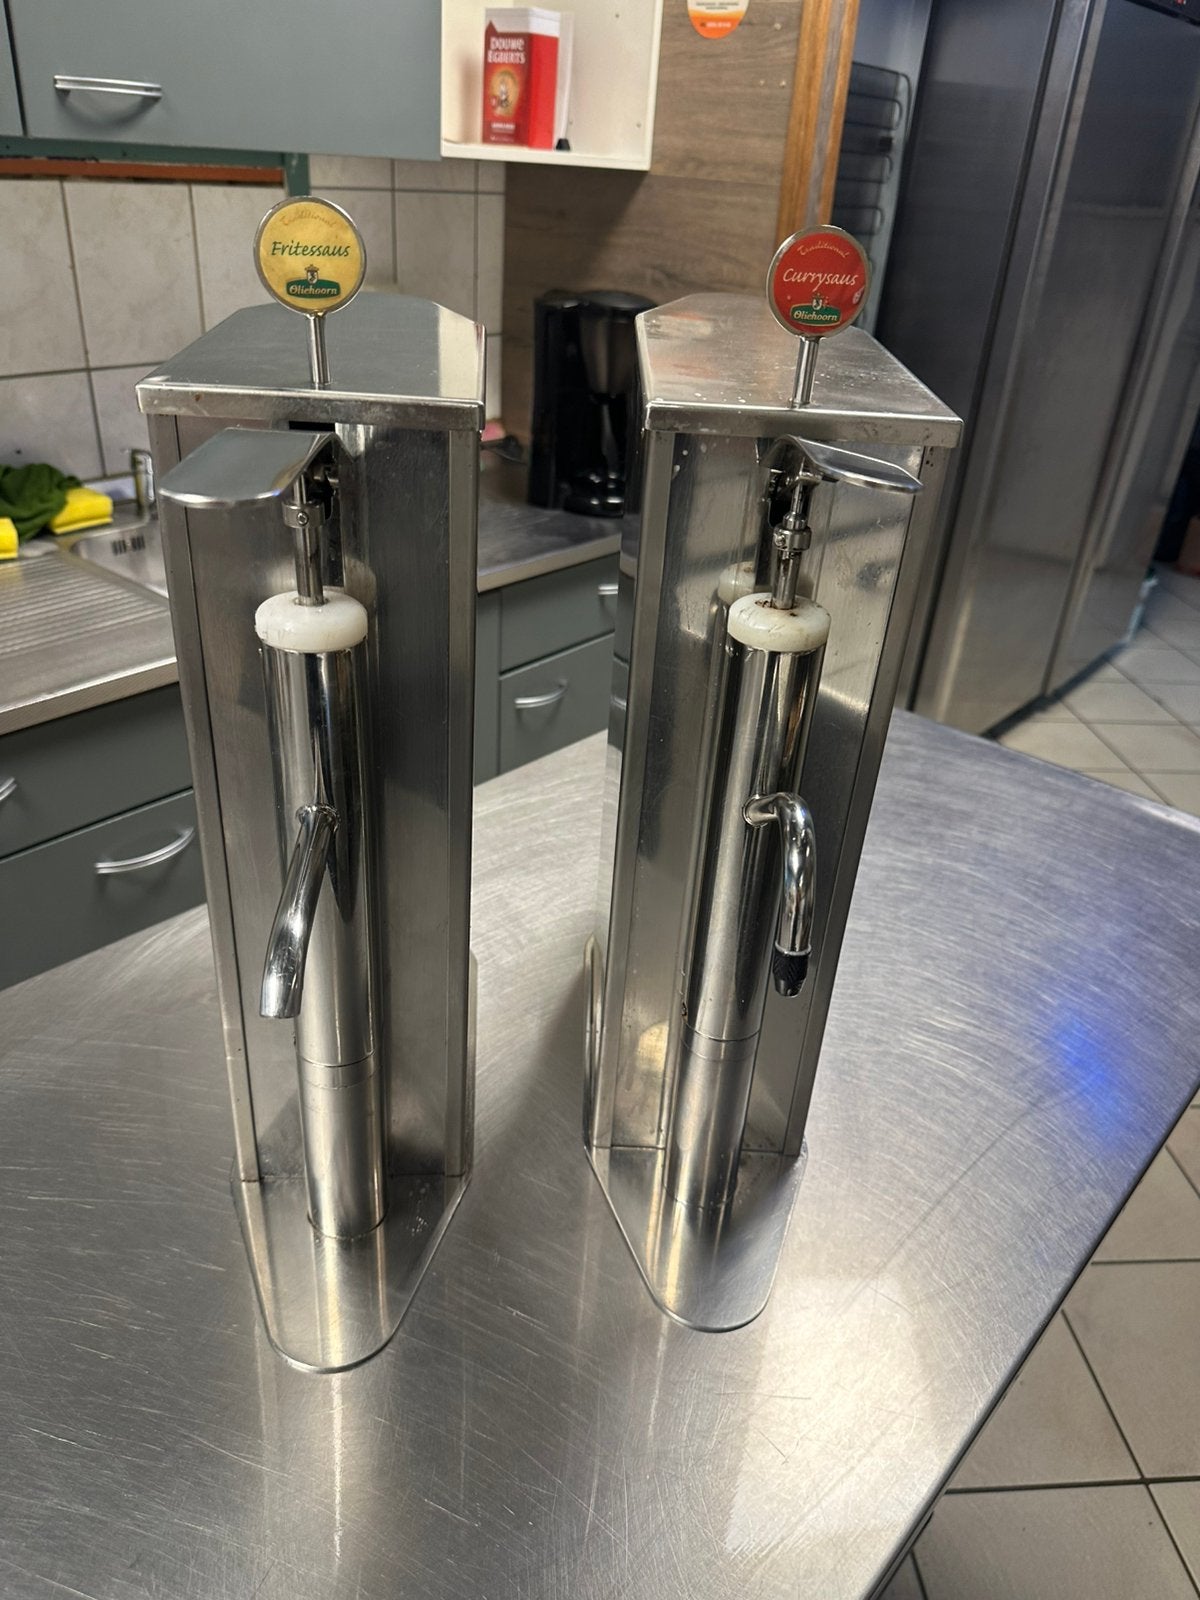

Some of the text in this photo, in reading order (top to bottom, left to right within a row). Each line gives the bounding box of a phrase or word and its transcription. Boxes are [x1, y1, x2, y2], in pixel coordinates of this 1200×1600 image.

[490, 37, 525, 50] DOUWE
[488, 51, 526, 63] EGBERTS
[271, 240, 351, 257] Fritessaus
[797, 241, 851, 258] Traditional
[783, 268, 859, 292] Currysaus
[289, 285, 337, 295] Oliehoorn
[793, 310, 838, 321] Oliehoorn
